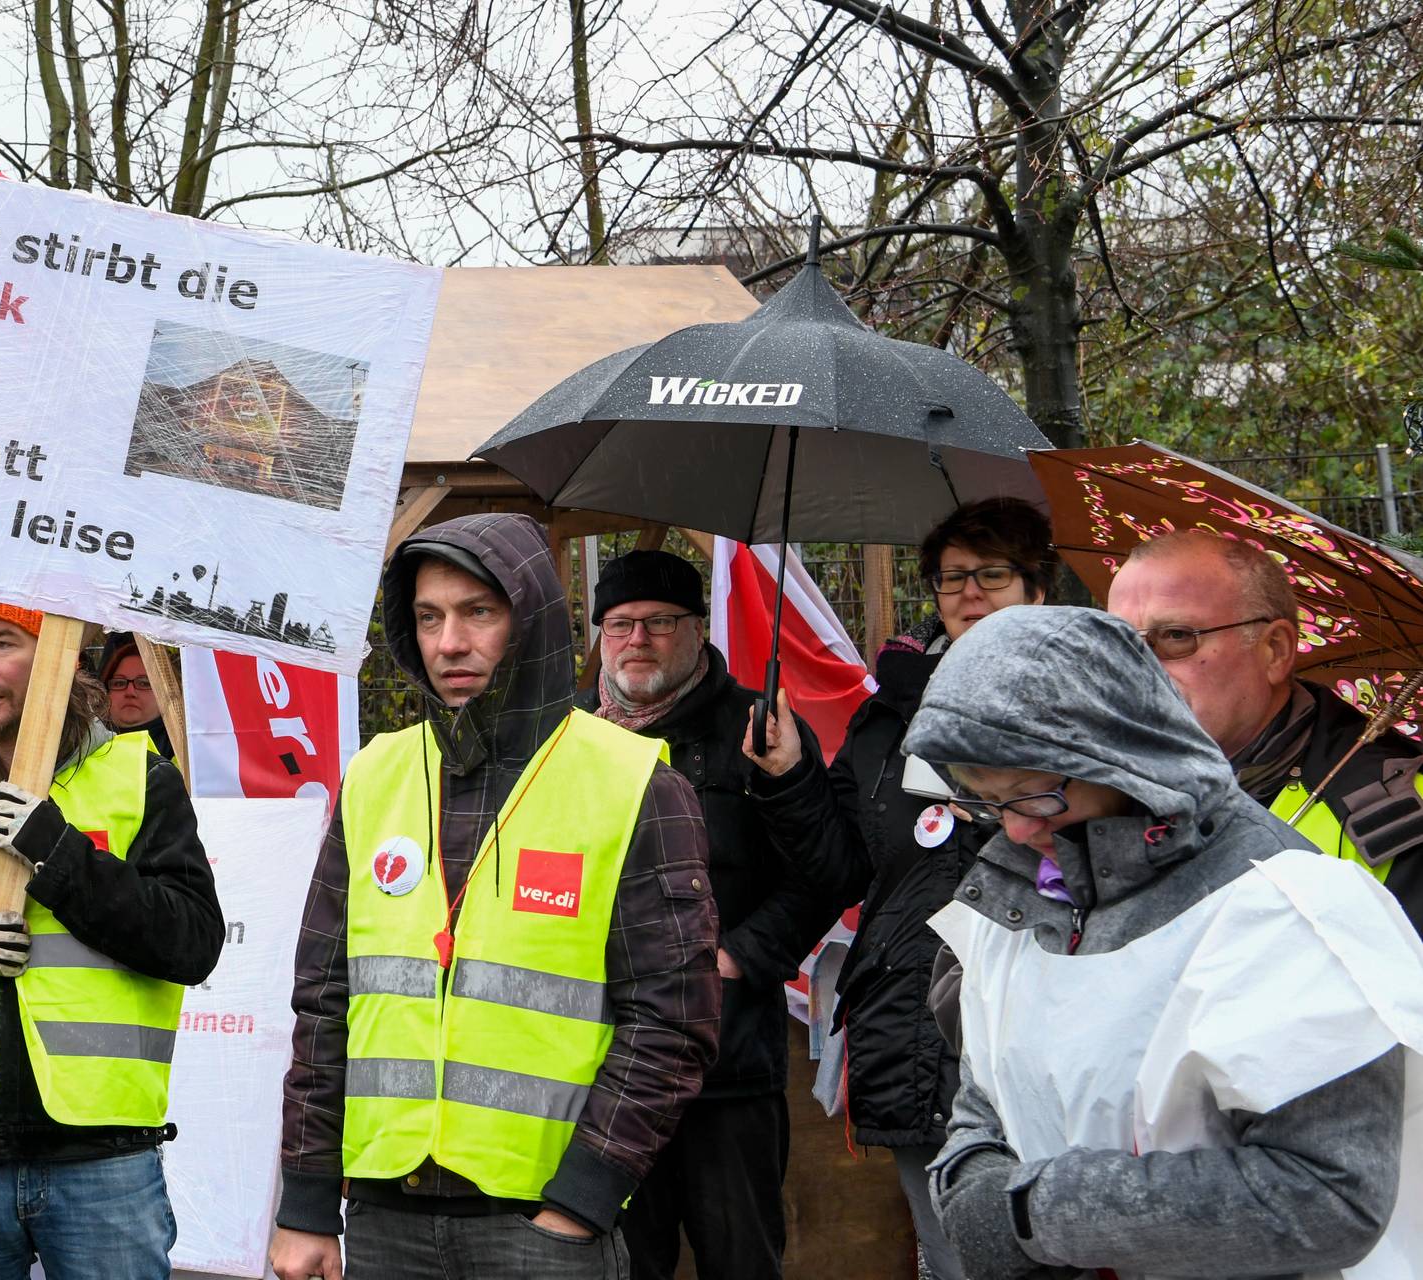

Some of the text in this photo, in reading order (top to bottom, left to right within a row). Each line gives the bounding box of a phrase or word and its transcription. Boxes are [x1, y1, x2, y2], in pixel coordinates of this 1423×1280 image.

[12, 232, 162, 291] stirbt
[177, 262, 259, 310] die
[10, 500, 135, 561] leise
[519, 885, 576, 909] ver.di
